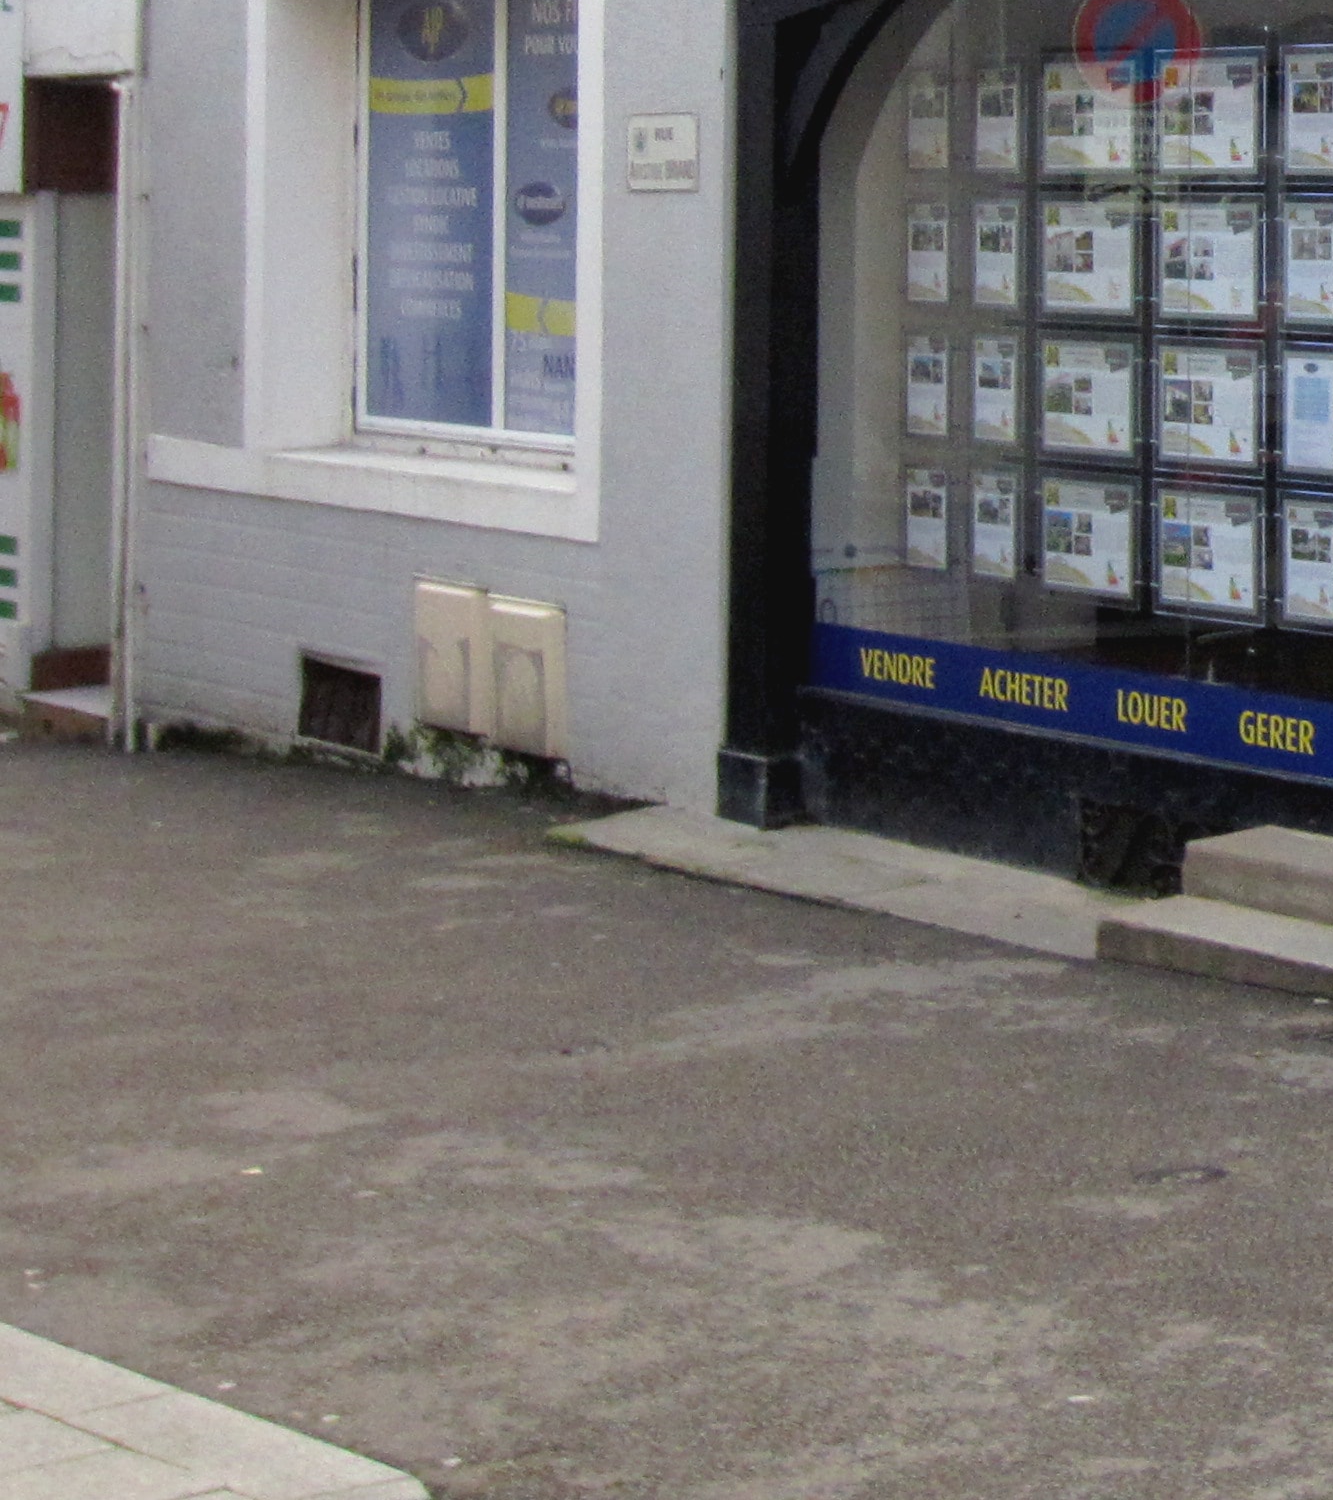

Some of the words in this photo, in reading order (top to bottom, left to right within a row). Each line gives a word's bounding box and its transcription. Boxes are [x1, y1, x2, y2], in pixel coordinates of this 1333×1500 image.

[859, 647, 936, 690] VENDRE
[979, 666, 1069, 712] ACHETER
[1116, 688, 1188, 733] LOUER
[1238, 708, 1315, 756] GERER
